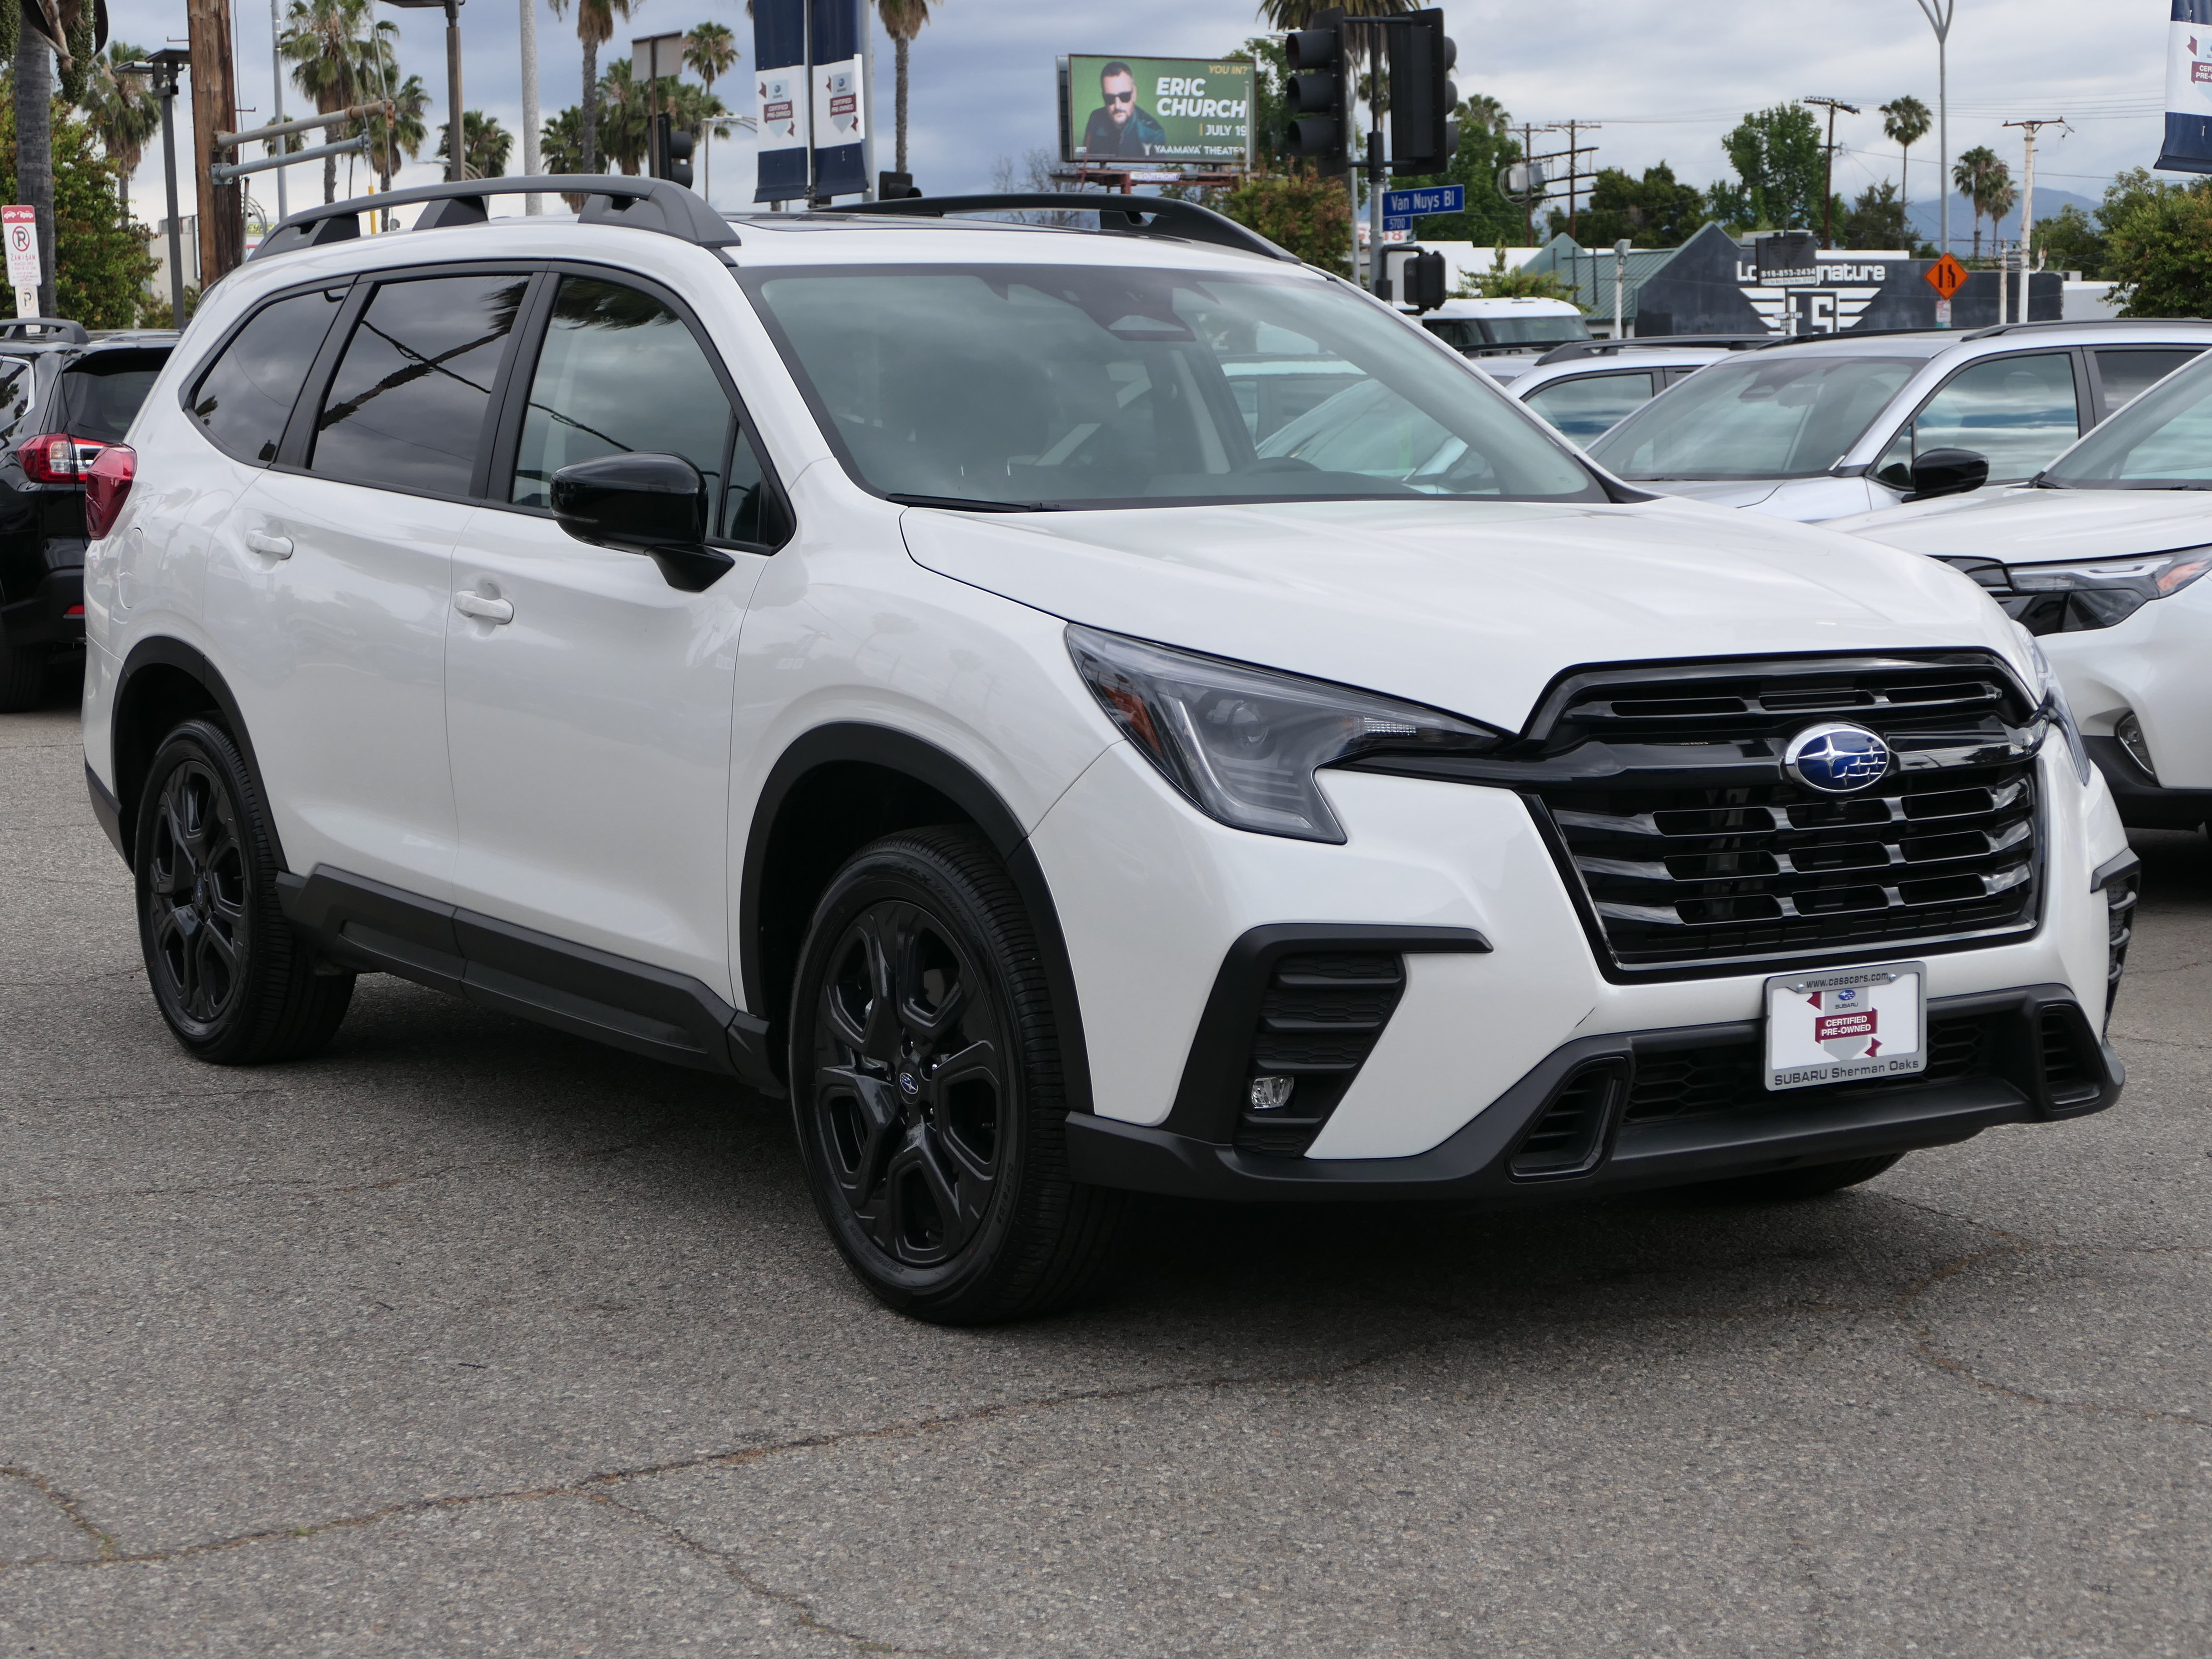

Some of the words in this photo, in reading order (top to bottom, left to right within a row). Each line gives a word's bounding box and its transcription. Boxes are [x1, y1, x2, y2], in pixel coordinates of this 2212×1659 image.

[1209, 65, 1230, 74] YOU
[1156, 77, 1206, 97] ERIC
[768, 104, 789, 112] CERTIFIED
[832, 98, 852, 106] CERTIFIED
[1156, 97, 1247, 119] CHURCH
[831, 104, 854, 113] PRE-OWNED
[1205, 124, 1232, 136] JULY
[1391, 195, 1409, 211] Van
[1413, 193, 1439, 212] Nuys
[1389, 218, 1406, 229] 5700
[1806, 972, 1888, 989] www.casacars.com
[1826, 1016, 1867, 1027] CERTIFIED
[1822, 1024, 1871, 1037] PRE-OWNED
[1775, 1069, 1827, 1086] SUBARU
[1832, 1063, 1885, 1078] Sherman
[1890, 1059, 1919, 1071] Oaks
